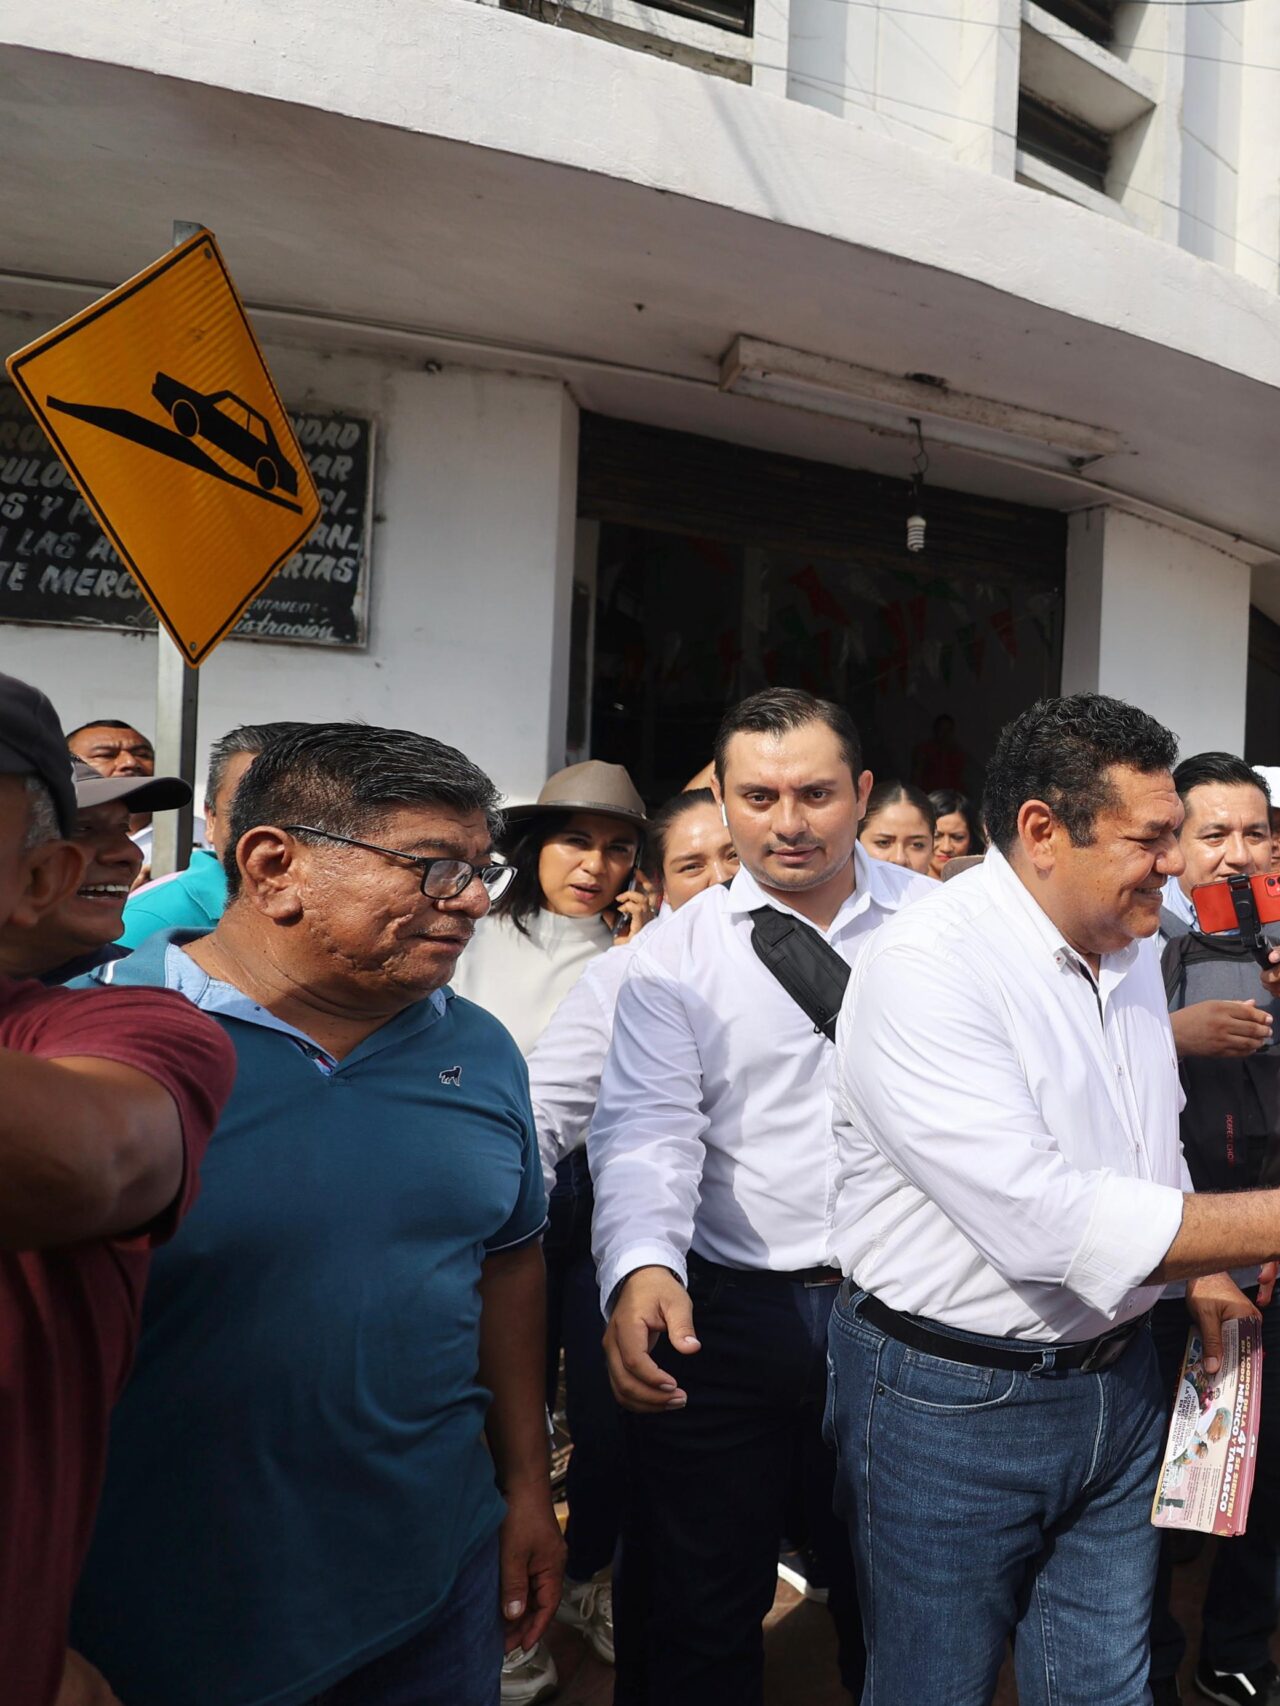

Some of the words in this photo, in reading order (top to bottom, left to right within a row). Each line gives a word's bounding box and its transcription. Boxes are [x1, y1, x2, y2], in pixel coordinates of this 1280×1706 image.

[16, 528, 81, 558] LAS
[1240, 1340, 1246, 1353] EN
[1242, 1399, 1249, 1412] DE
[1240, 1414, 1247, 1427] LA
[1235, 1430, 1247, 1458] 4T
[1234, 1457, 1241, 1471] SE
[1219, 1446, 1236, 1512] TABASCO
[1226, 1472, 1239, 1518] SIENTEN
